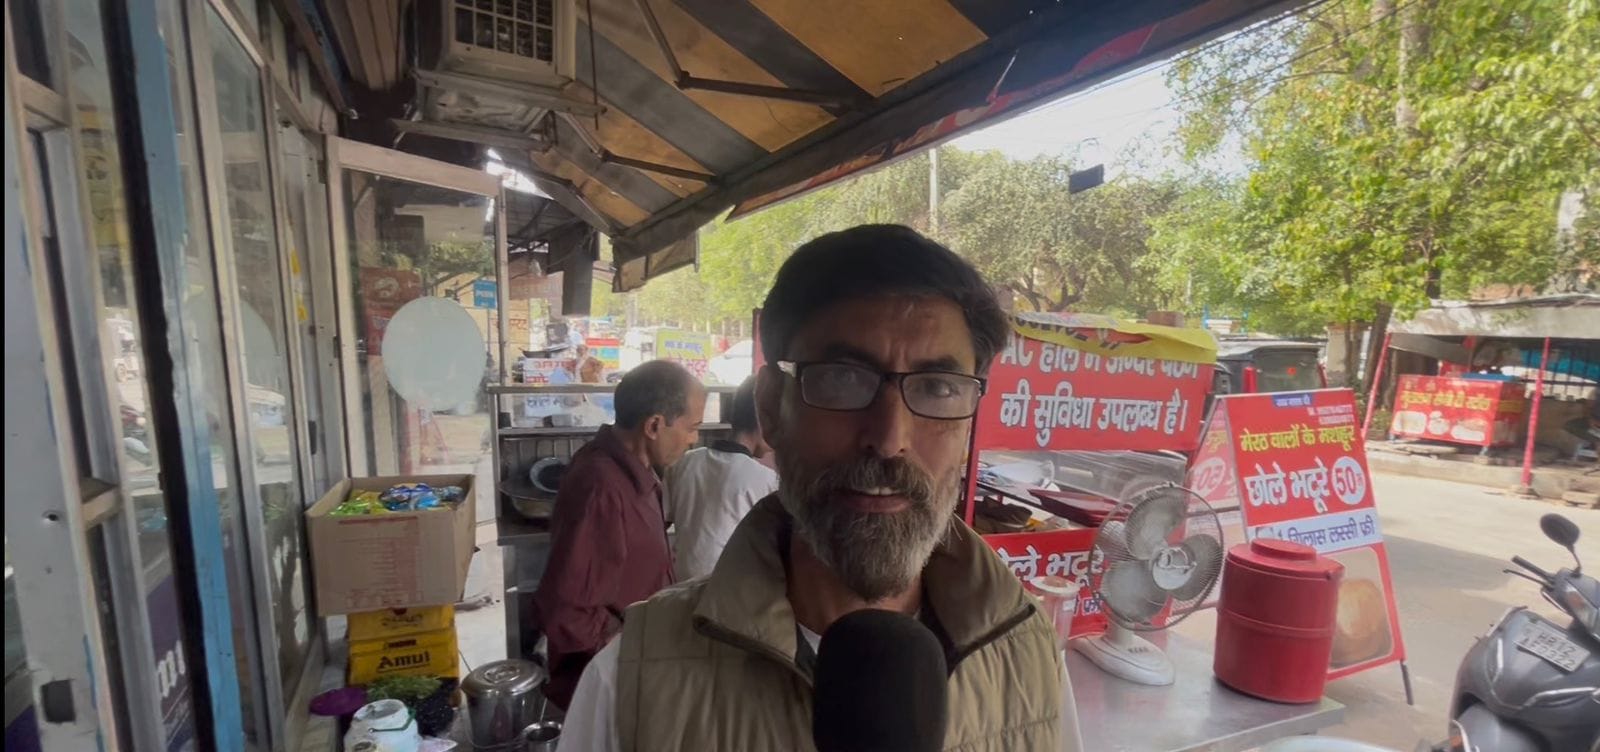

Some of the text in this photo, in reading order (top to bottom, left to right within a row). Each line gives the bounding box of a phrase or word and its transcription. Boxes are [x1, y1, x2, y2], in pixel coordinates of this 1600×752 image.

[1000, 378, 1031, 428] की
[1034, 382, 1096, 448] सुविधा
[1097, 398, 1163, 432] उपलब्ध
[1240, 428, 1269, 452] मेरठ
[1269, 424, 1300, 449] वालों
[1301, 423, 1316, 446] के
[1243, 463, 1288, 507] छोले
[1289, 455, 1331, 514] भटूरे
[1328, 517, 1359, 544] लस्सी
[377, 650, 431, 670] Amul
